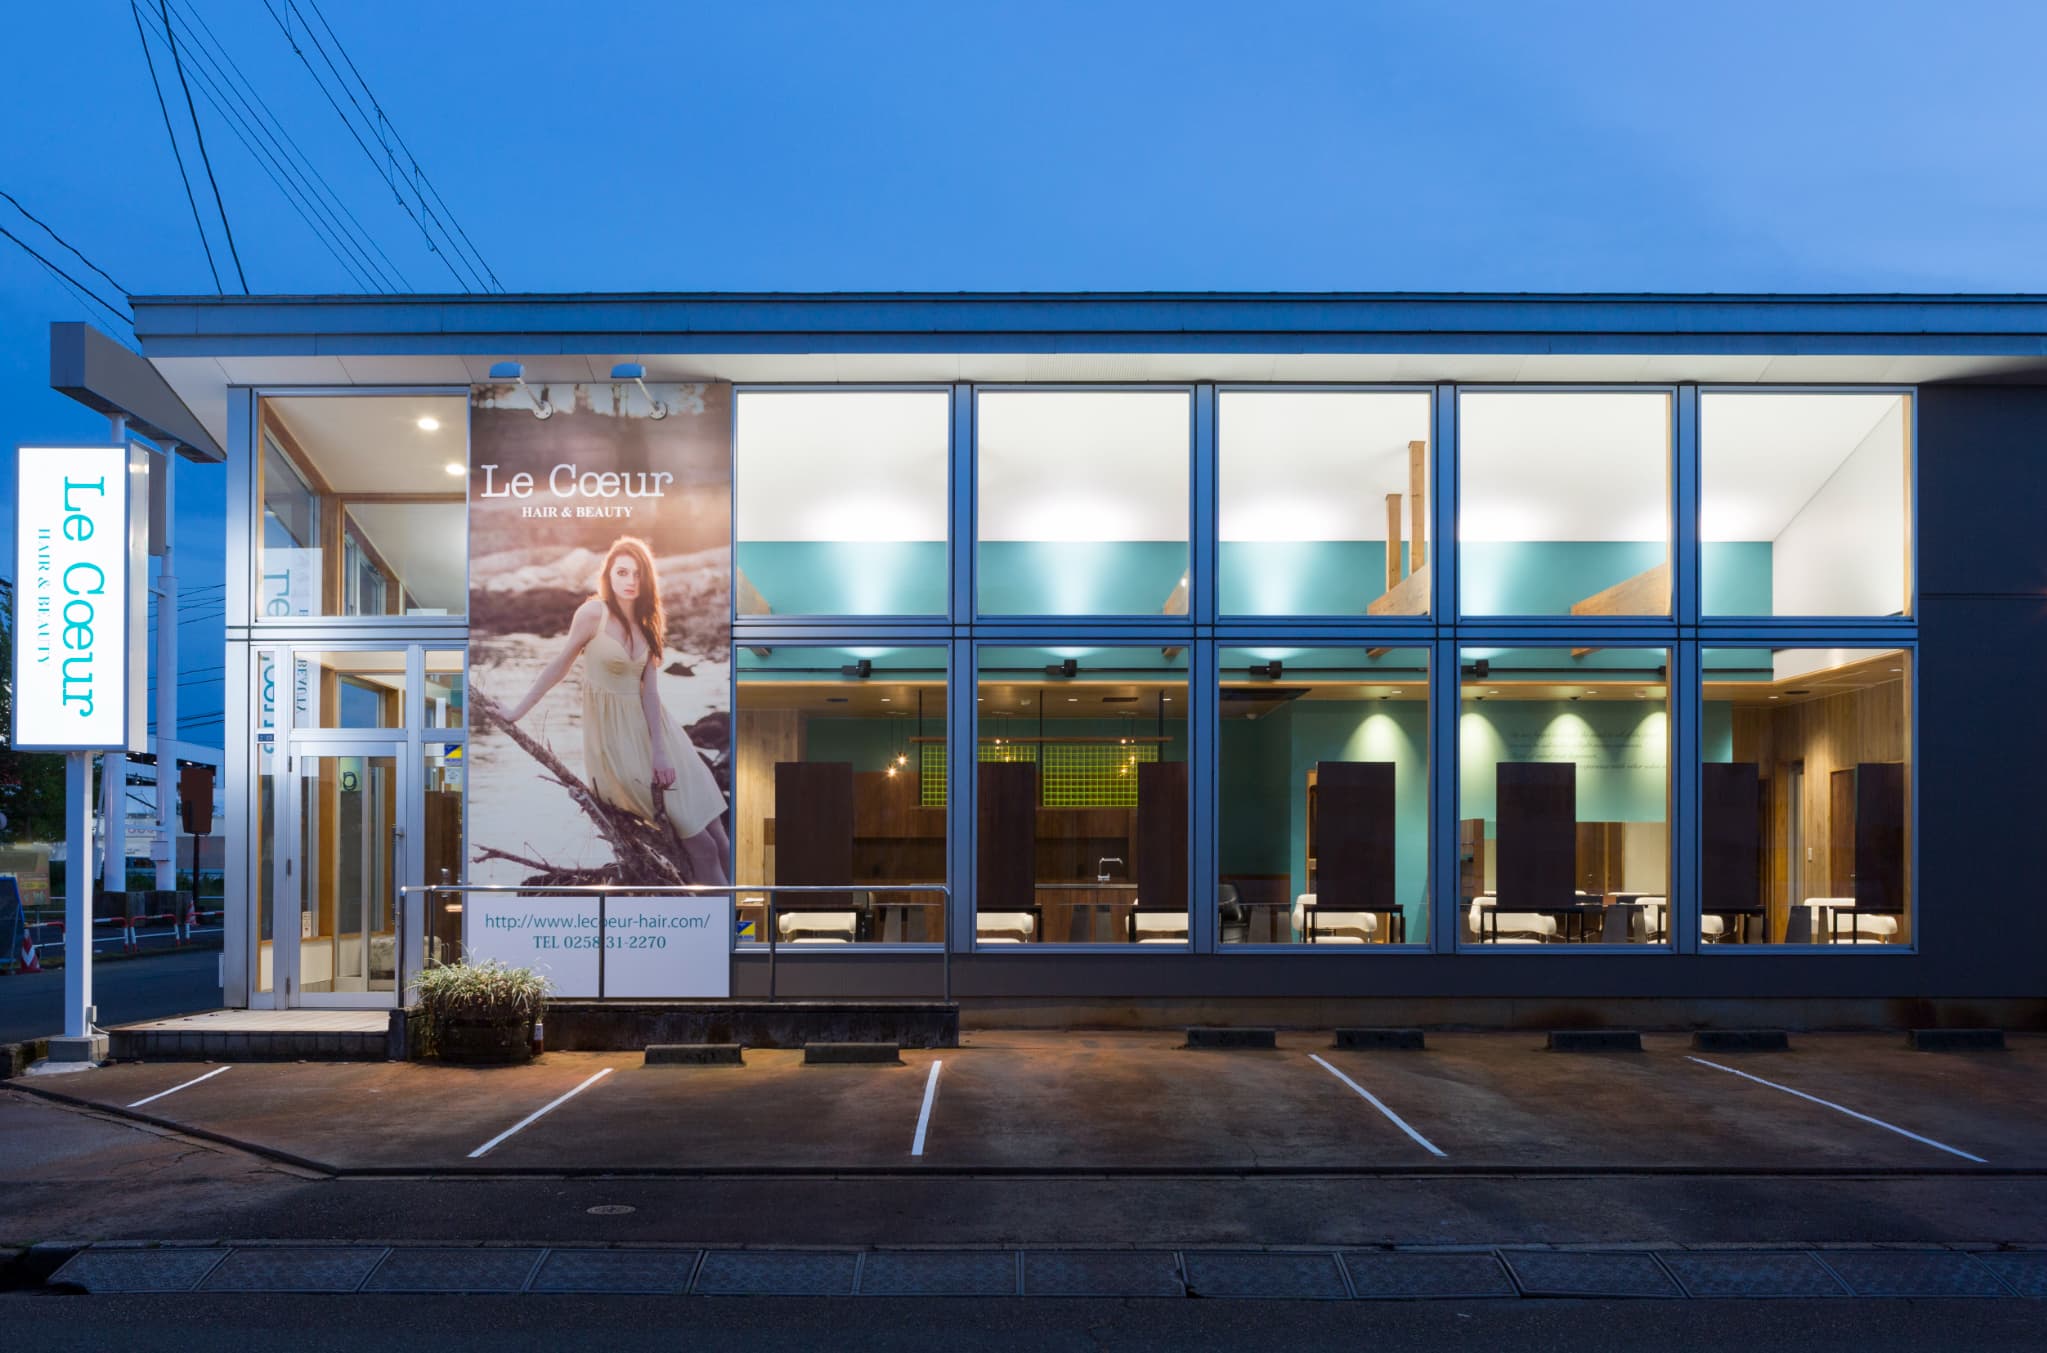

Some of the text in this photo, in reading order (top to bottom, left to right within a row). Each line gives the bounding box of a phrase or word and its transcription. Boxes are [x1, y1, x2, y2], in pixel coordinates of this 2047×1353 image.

[481, 463, 674, 499] Le Cœur
[522, 506, 633, 518] HAIR & BEAUTY
[37, 528, 51, 664] HAIR & BEAUTY
[62, 475, 105, 718] Le Cœur
[533, 935, 667, 949] TEL 025831-2270
